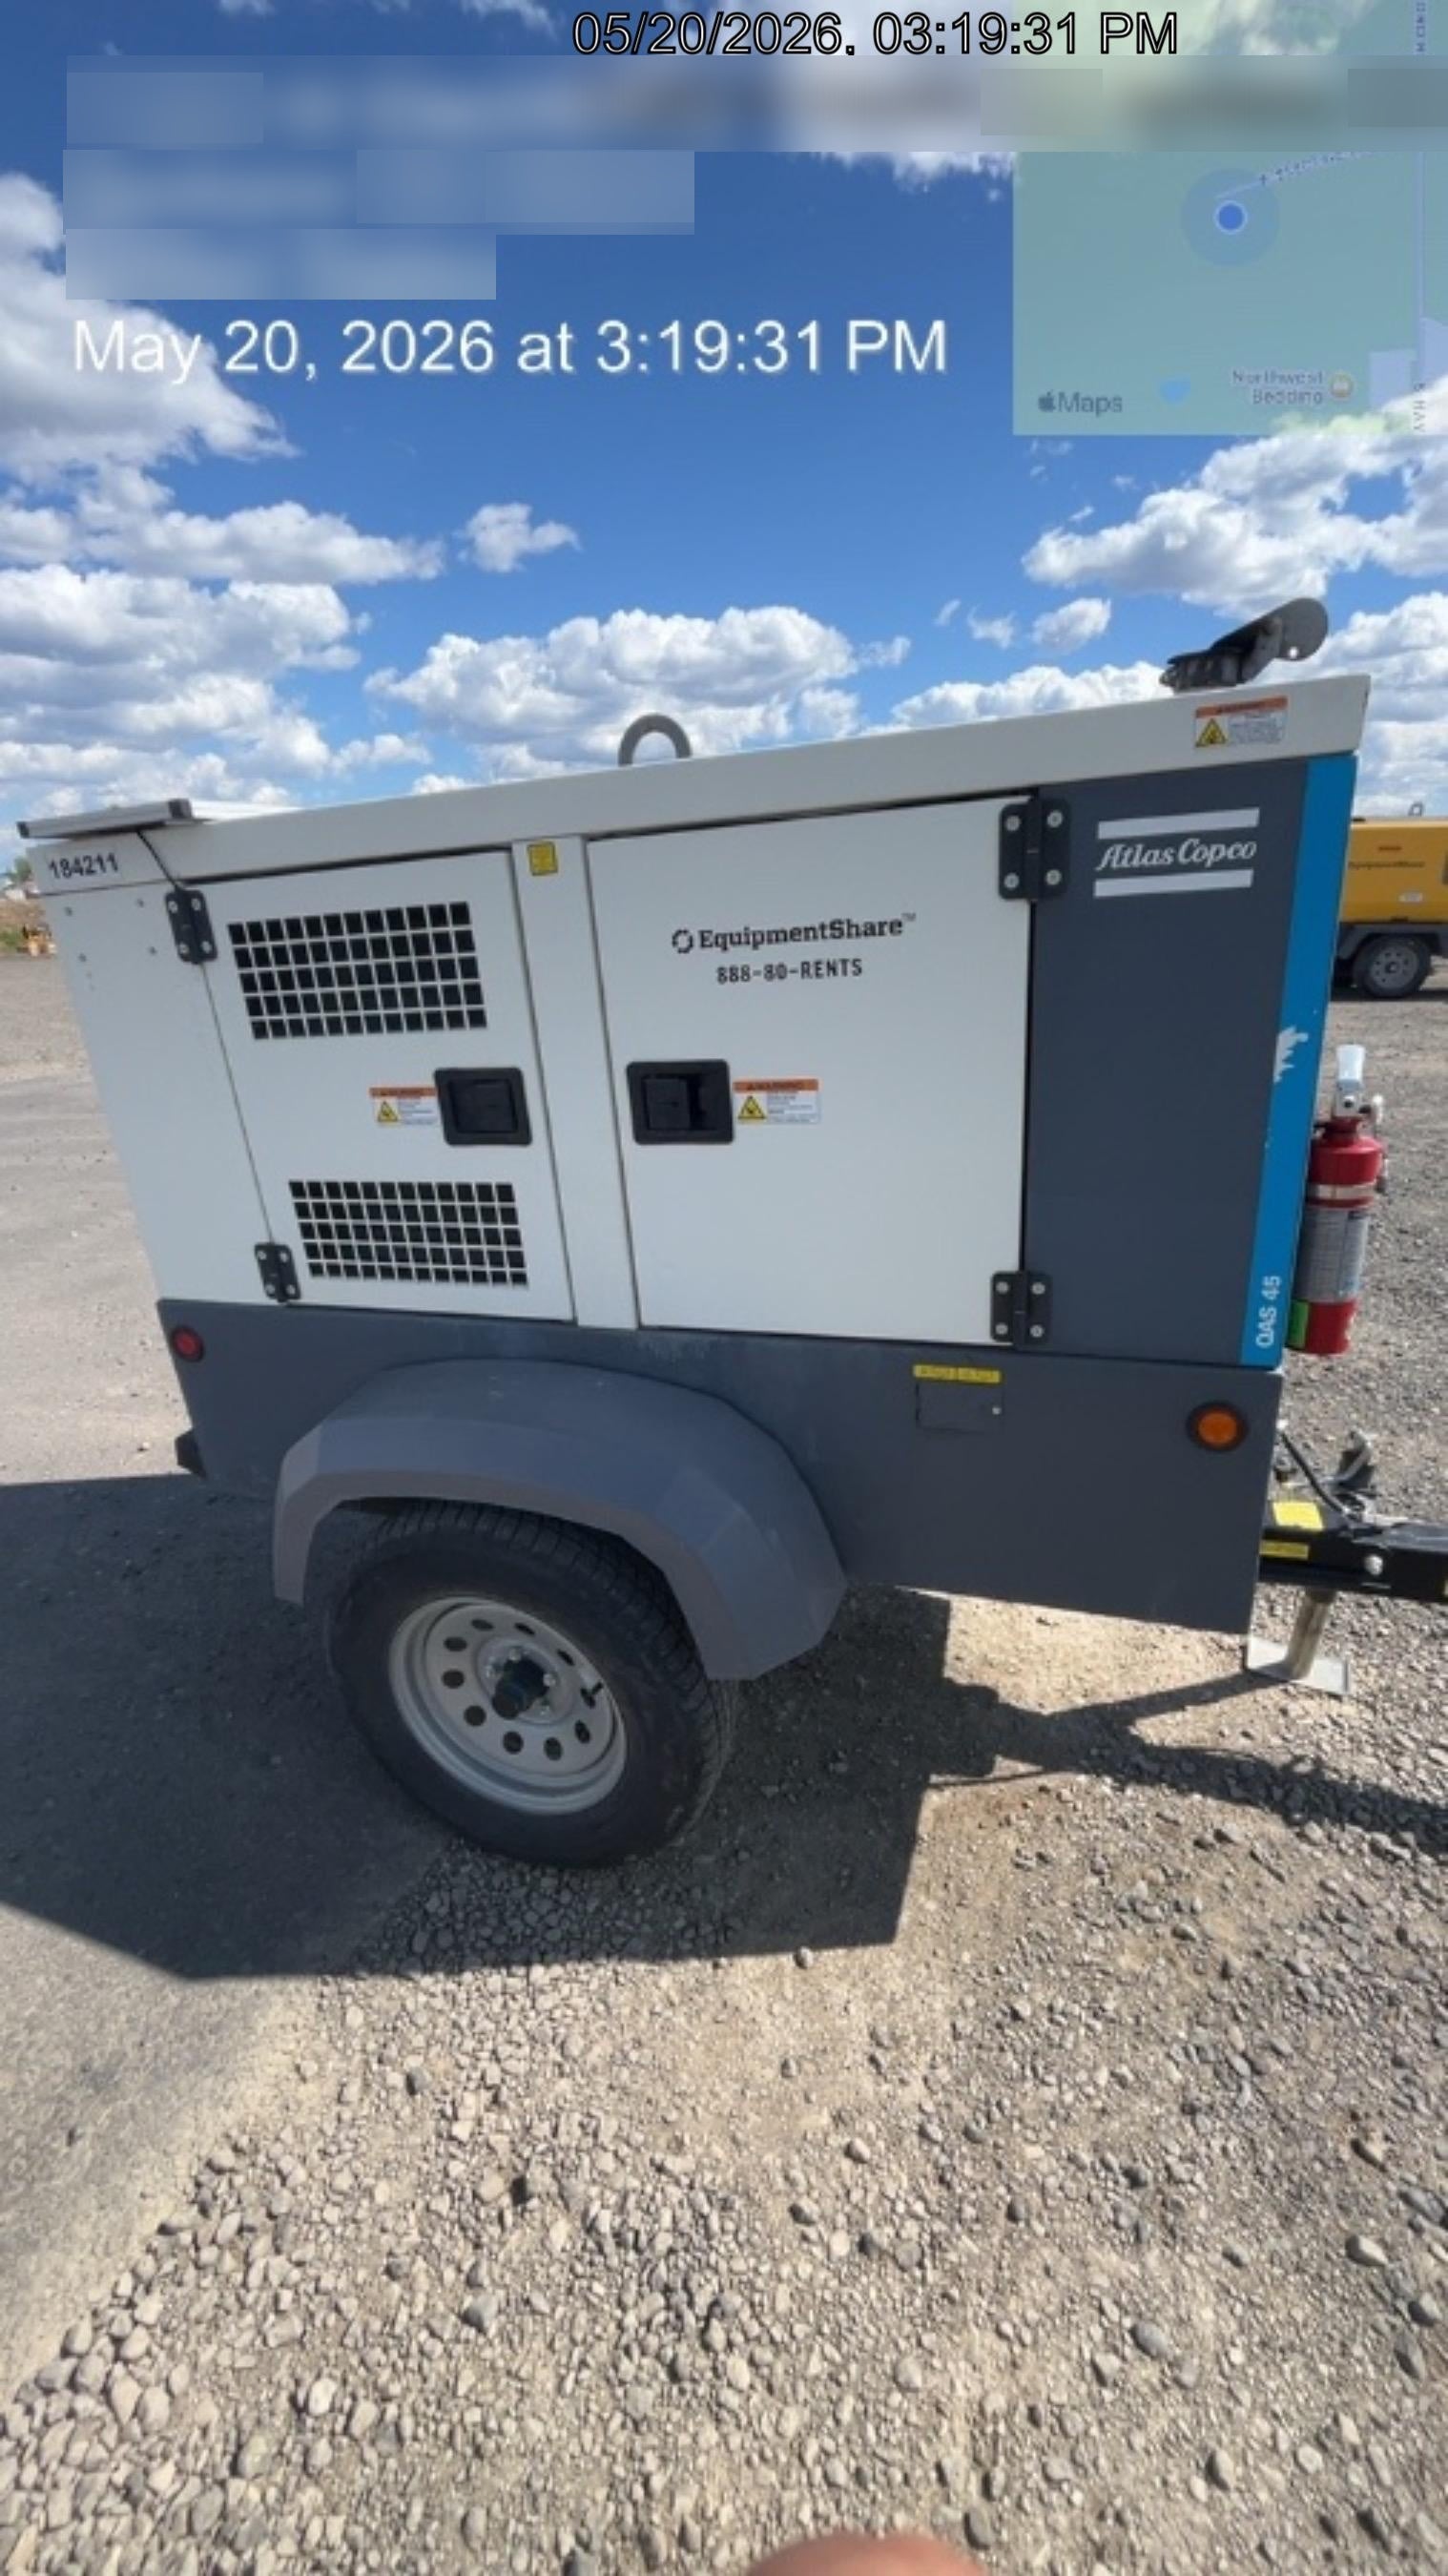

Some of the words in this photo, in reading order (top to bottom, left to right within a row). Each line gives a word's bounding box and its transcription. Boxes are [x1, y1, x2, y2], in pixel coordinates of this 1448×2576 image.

[48, 851, 118, 880] 184211
[1094, 843, 1175, 872] Atlas
[1177, 838, 1257, 868] Copco
[698, 918, 904, 951] EquipmentShare
[716, 957, 863, 985] 888-80-RENTS
[1260, 1276, 1281, 1300] 45
[1255, 1306, 1277, 1349] QAS
